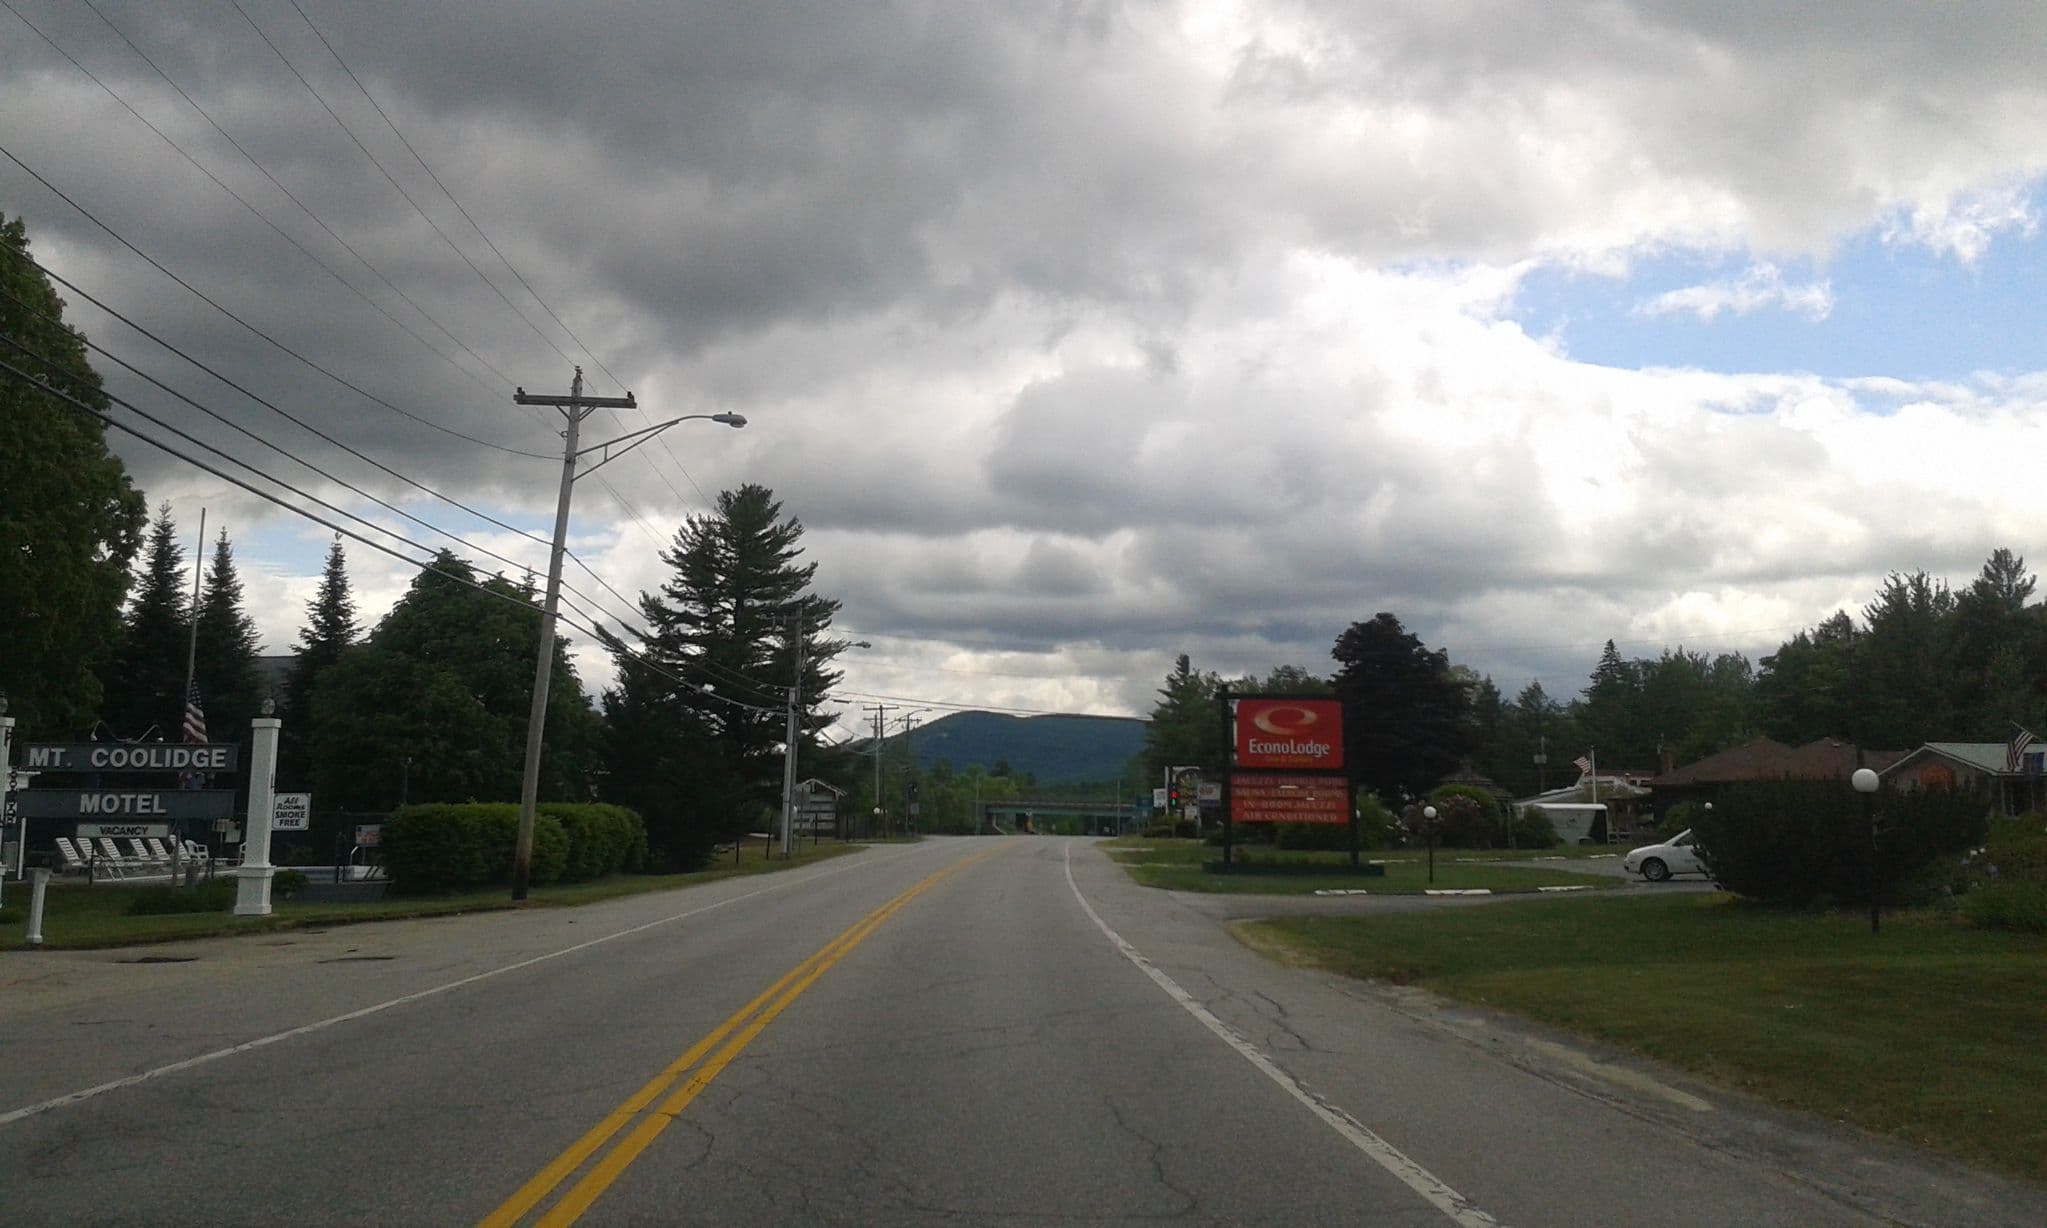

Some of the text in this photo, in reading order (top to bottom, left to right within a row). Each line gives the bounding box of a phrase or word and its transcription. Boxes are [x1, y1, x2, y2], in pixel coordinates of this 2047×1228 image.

[1249, 738, 1330, 758] EconoLodge
[28, 748, 227, 768] MT. COOLIDGE
[79, 794, 167, 814] MOTEL
[275, 811, 306, 819] SMOKE
[100, 825, 149, 836] VACANCY
[279, 819, 300, 827] FREE
